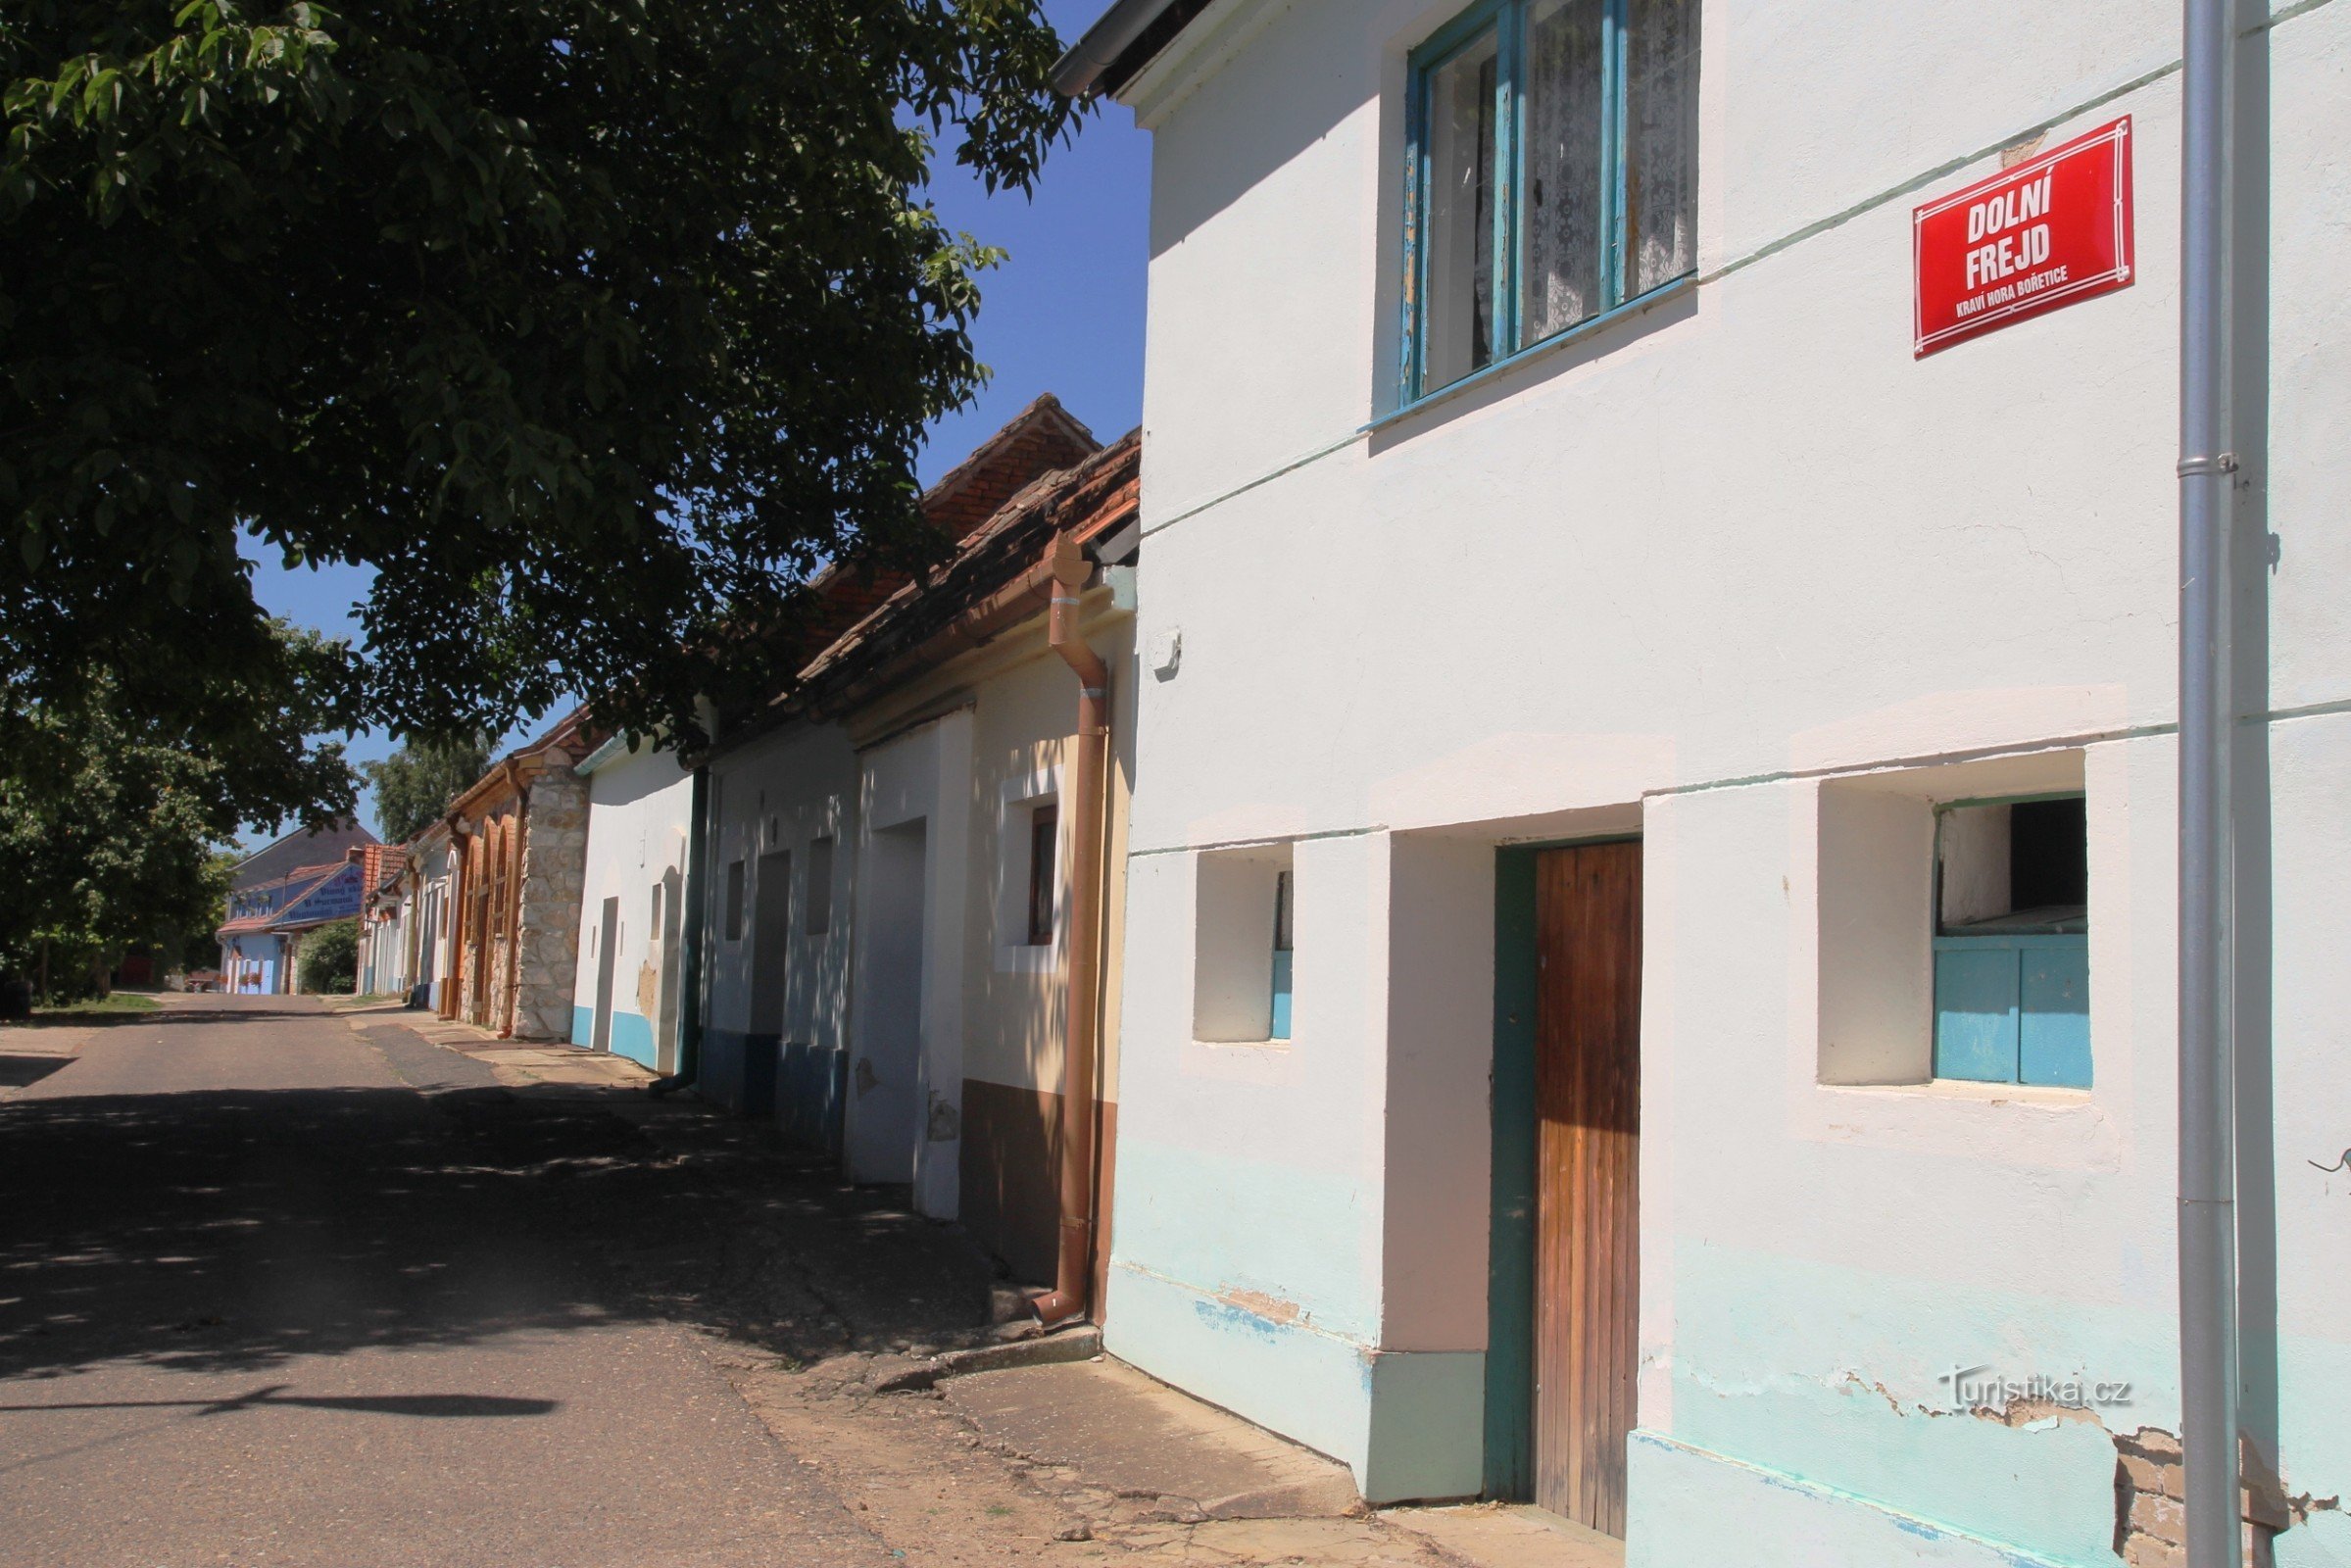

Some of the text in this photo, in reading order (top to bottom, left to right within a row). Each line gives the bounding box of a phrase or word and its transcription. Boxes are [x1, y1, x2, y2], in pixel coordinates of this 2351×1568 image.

[1968, 166, 2054, 244] DOLNÍ
[1966, 223, 2050, 290] FREJD
[1956, 265, 2068, 318] KRAVÍ HORA BOŘETICE
